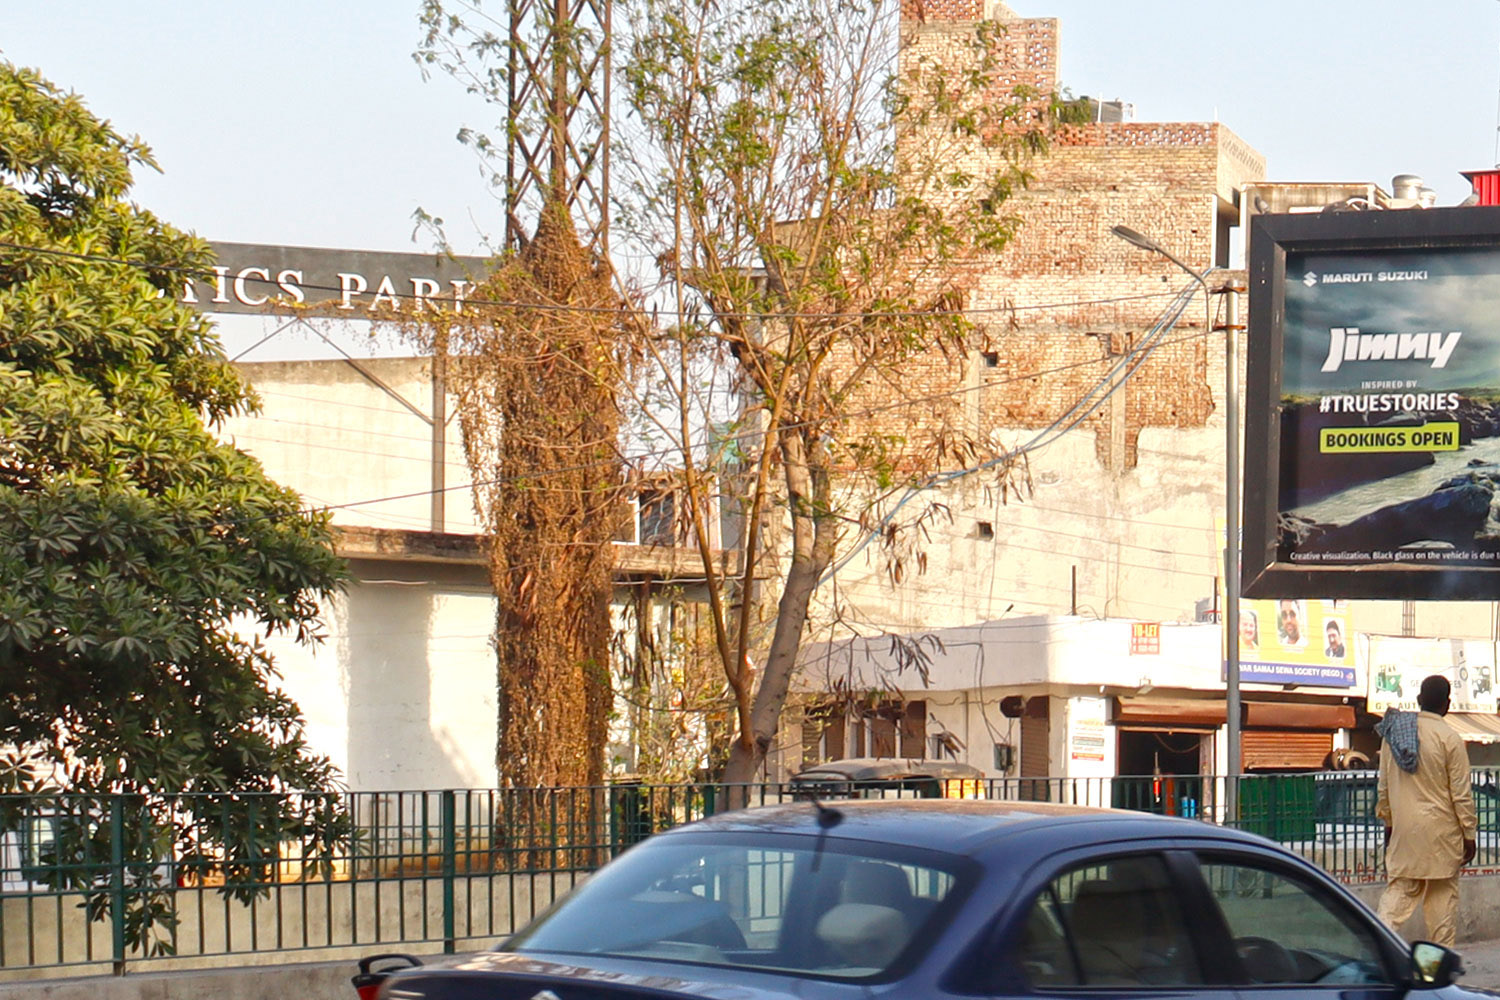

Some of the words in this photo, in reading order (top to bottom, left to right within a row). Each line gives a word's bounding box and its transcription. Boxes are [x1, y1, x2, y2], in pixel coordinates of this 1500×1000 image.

[1322, 272, 1373, 284] MARUTI
[1377, 270, 1428, 282] SUZUKI
[337, 272, 485, 314] PARK
[1320, 327, 1463, 373] Jimny
[1361, 380, 1403, 390] INSPIRED
[1405, 379, 1418, 389] BY
[1319, 392, 1460, 413] #TRUESTORIES
[1326, 432, 1406, 448] BOOKINGS
[1411, 431, 1453, 447] OPEN
[1289, 551, 1321, 560] Creative
[1322, 551, 1371, 560] visualization.
[1372, 551, 1393, 560] Black
[1394, 551, 1414, 562] glass
[1415, 552, 1427, 560] on
[1427, 551, 1440, 560] the
[1442, 551, 1470, 560] vehicle
[1471, 551, 1478, 560] is
[1480, 551, 1495, 560] due
[1295, 667, 1320, 677] SOCIETY
